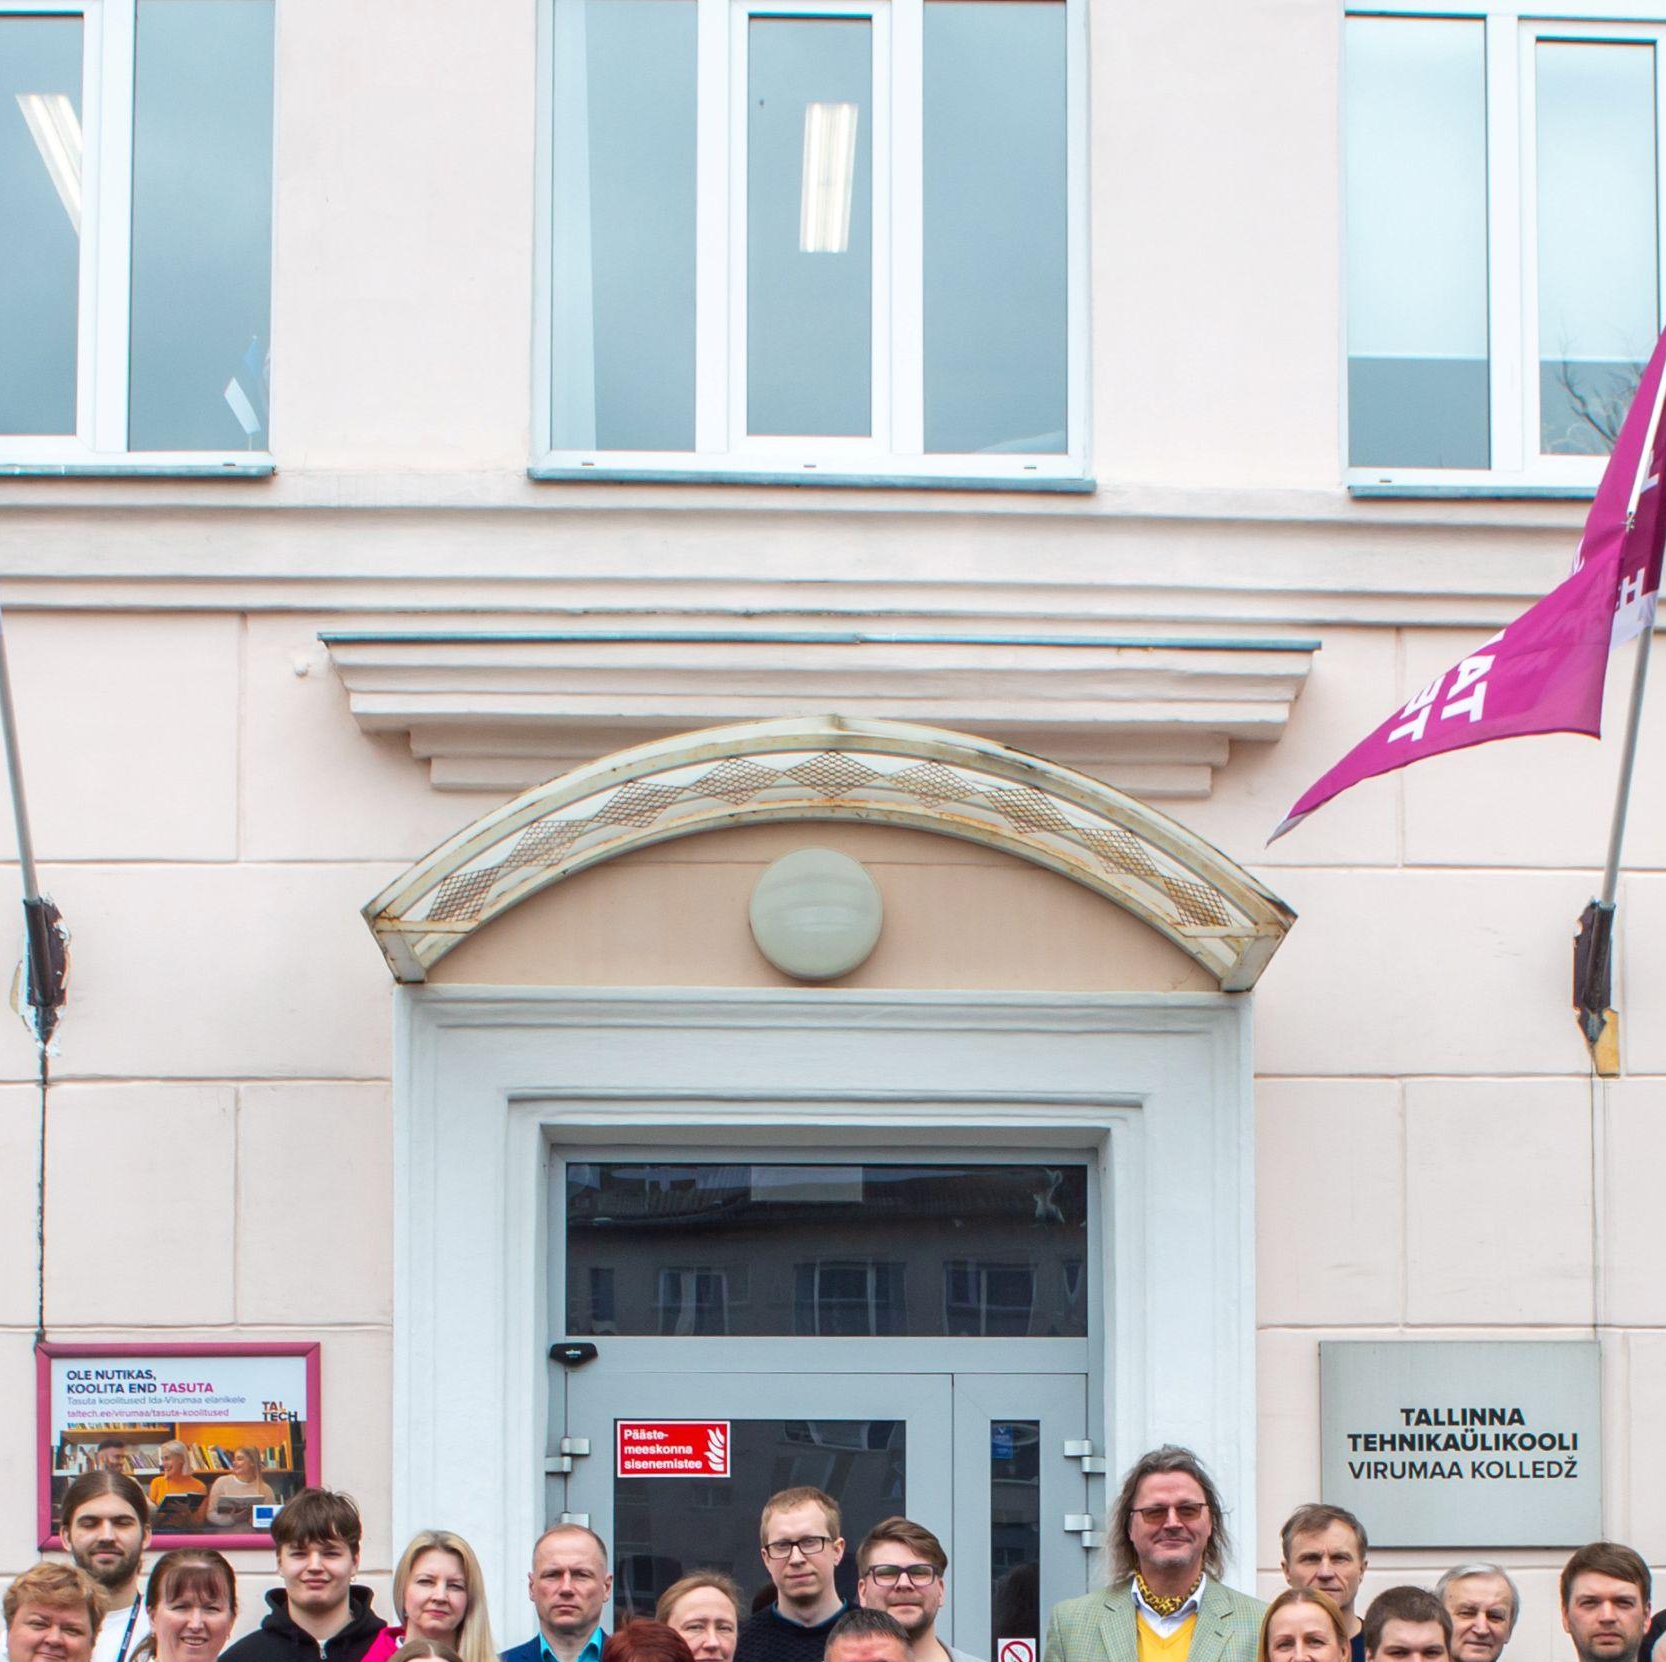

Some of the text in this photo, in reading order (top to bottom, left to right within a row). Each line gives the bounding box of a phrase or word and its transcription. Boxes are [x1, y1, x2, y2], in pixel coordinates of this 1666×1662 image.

[66, 1368, 157, 1381] OLE NUTIKAS,
[66, 1382, 214, 1394] KOOLITA END TASUTA
[67, 1396, 97, 1405] Tasuta
[99, 1395, 146, 1405] koolitused
[262, 1411, 299, 1422] TECH
[1400, 1407, 1526, 1426] TALLINNA
[623, 1429, 669, 1440] Pääste-
[1347, 1428, 1579, 1452] TEHNIKAÜLIKOOLI
[623, 1444, 694, 1455] meeskonna
[623, 1458, 703, 1469] sisenemistee
[1348, 1455, 1579, 1479] VIRUMAA KOLLEDŽ
